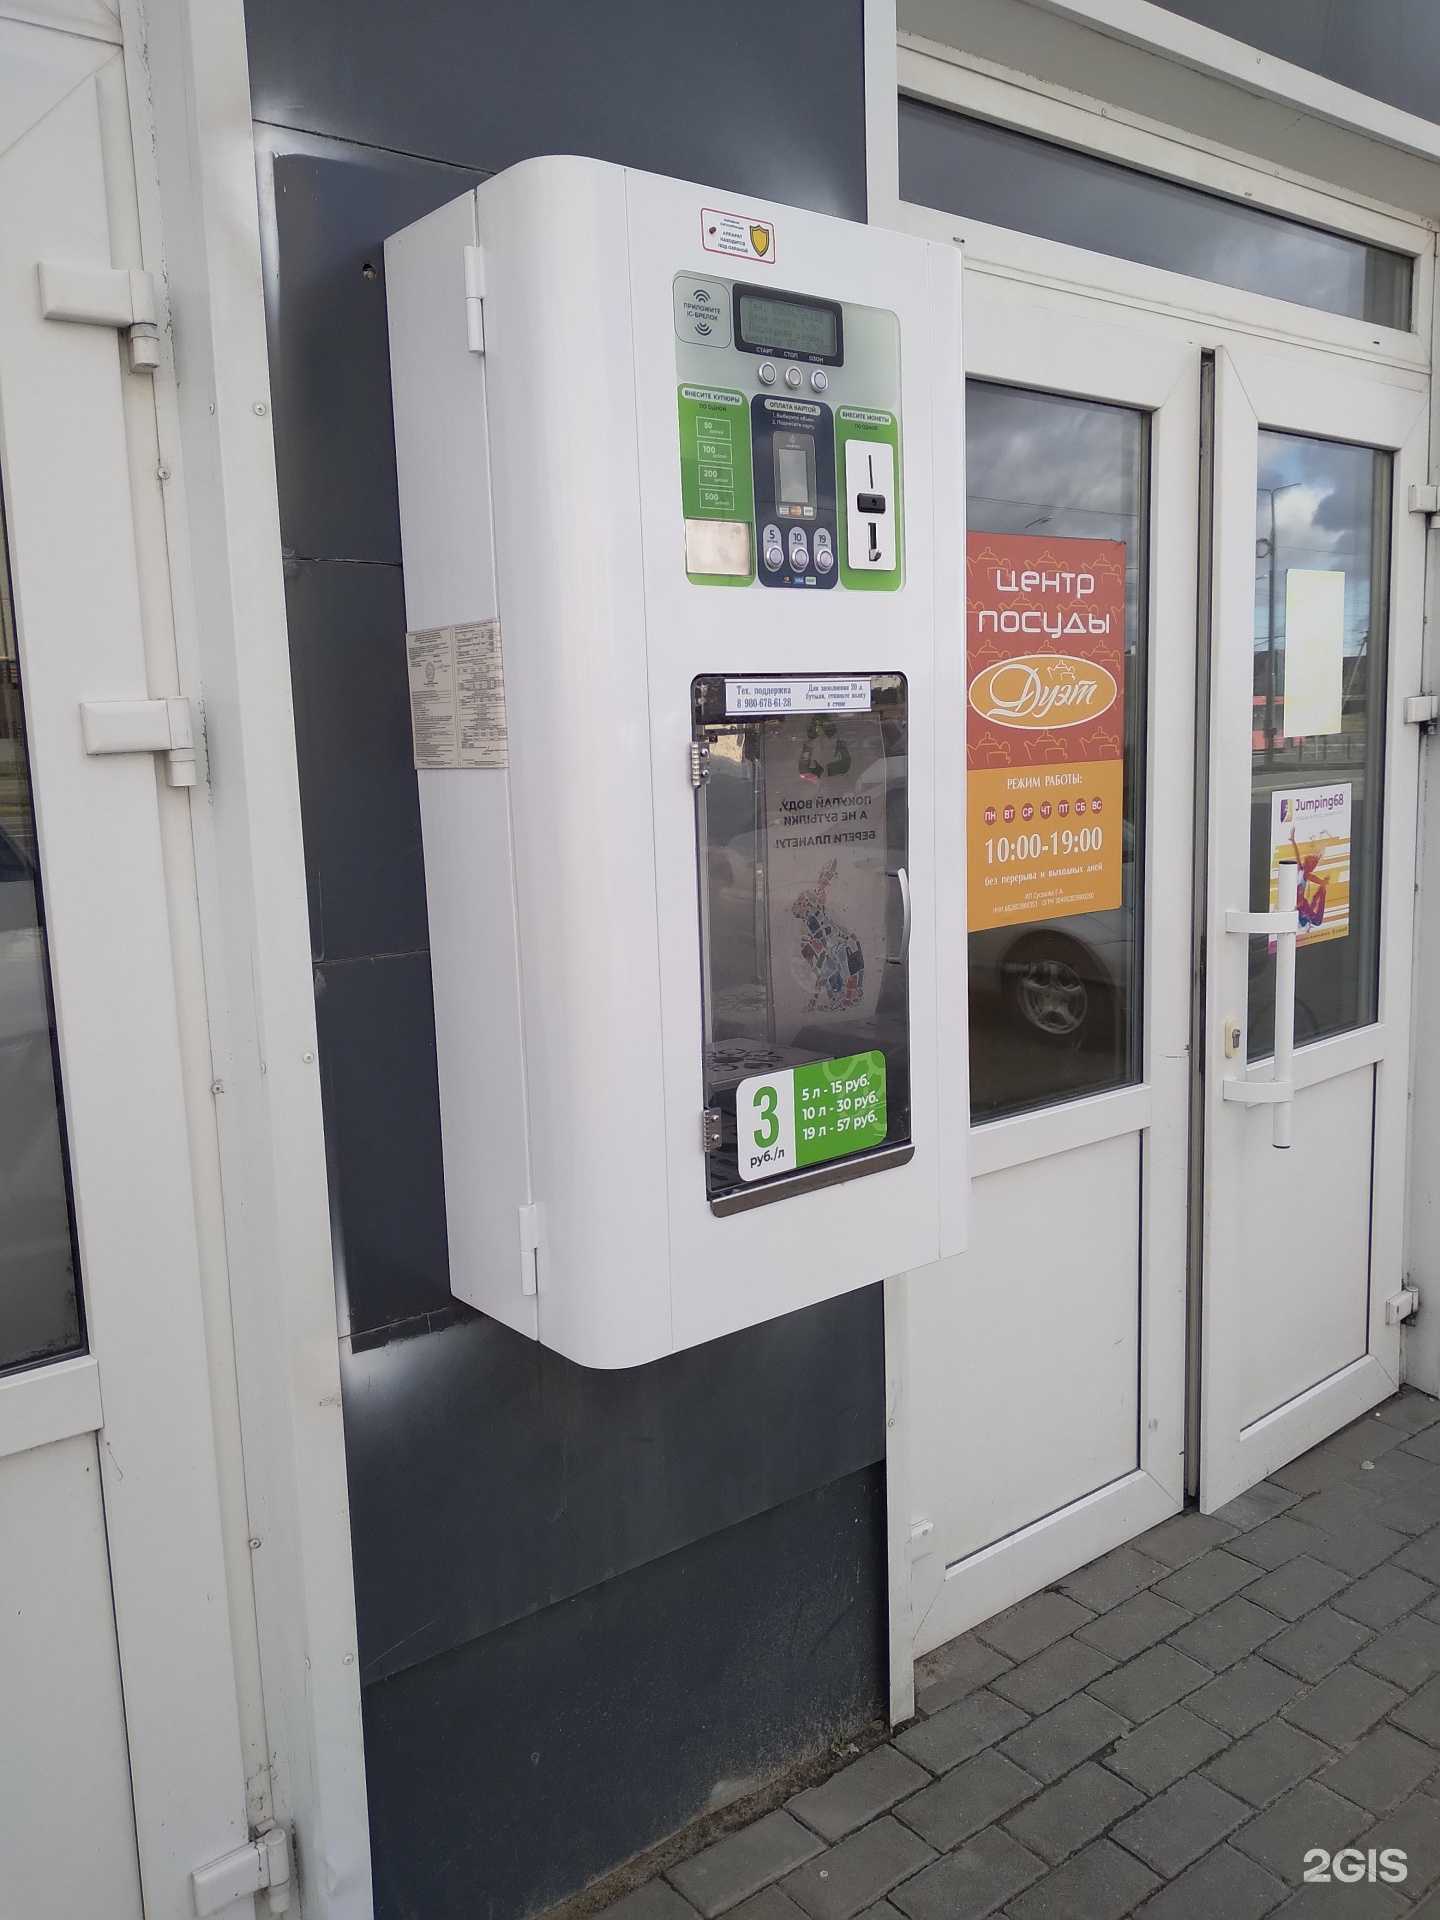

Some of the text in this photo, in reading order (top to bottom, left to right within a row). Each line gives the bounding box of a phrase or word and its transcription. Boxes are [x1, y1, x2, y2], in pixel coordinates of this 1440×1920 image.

[683, 302, 720, 314] ПРИЛОЖИТЕ
[756, 346, 824, 363] СТАРТ СТОП ОЗОН
[684, 389, 740, 403] ВНЕСИТЕ КУПЮРЫ
[770, 402, 816, 413] ОПЛАТА КАРТОЙ
[704, 421, 713, 430] 50
[842, 411, 890, 423] ВНЕСИТЕ МОНЕТЫ
[703, 446, 716, 454] 100
[704, 470, 718, 478] 200
[705, 493, 719, 501] 500
[769, 530, 827, 544] 5 10 19
[736, 685, 792, 697] Тех. поддержка
[986, 663, 1098, 718] Дуэт
[736, 699, 742, 708] 8
[1007, 773, 1083, 790] РЕЖИМ РАБОТЫ:
[984, 800, 1102, 819] ПН ВТ СР ЧТ ПТ СБ ВС
[1295, 793, 1344, 812] Jumping68
[985, 826, 1103, 864] 10:00-19:00
[984, 876, 998, 887] без
[1001, 871, 1037, 886] перерыва
[1048, 866, 1084, 877] выходных
[1086, 862, 1103, 873] дней
[802, 1087, 810, 1101] 5
[812, 1087, 821, 1099] л
[830, 1081, 842, 1094] 15
[845, 1073, 870, 1094] руб.
[802, 1107, 816, 1121] 10
[818, 1106, 827, 1117] л
[836, 1097, 851, 1112] 30
[854, 1090, 879, 1110] руб.
[752, 1086, 779, 1149] 3
[802, 1127, 816, 1140] 19
[818, 1125, 827, 1137] л
[836, 1117, 851, 1132] 57
[853, 1109, 878, 1130] руб.
[750, 1146, 785, 1169] руб./л
